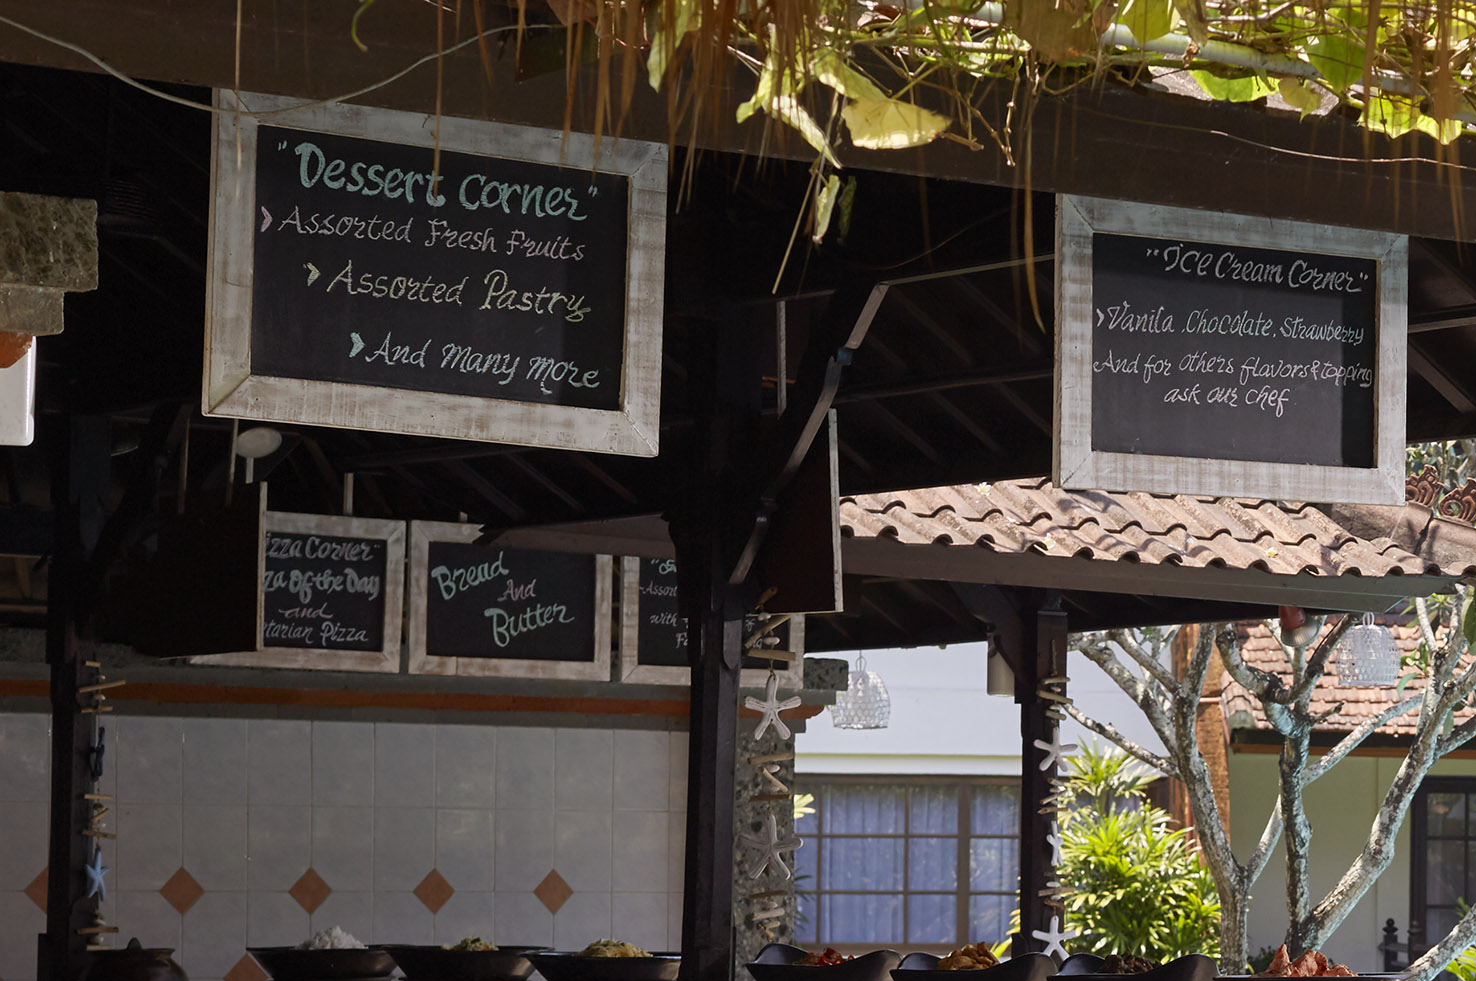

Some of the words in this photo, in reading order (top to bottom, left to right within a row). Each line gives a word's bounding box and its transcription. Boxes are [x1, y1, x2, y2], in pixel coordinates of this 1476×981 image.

[278, 140, 446, 207] "Dessert
[459, 174, 598, 221] Corner"
[277, 205, 416, 243] Assorted
[425, 218, 497, 253] Fresh
[506, 229, 586, 261] Fruits
[1214, 252, 1284, 285] Cream
[326, 259, 470, 306] Assorted
[479, 269, 592, 322] Pastry
[1107, 300, 1175, 334] Vanila
[1280, 316, 1364, 346] Strawberry
[365, 331, 432, 368] And
[1092, 349, 1141, 374] And
[1143, 354, 1172, 384] for
[1163, 383, 1200, 405] ask
[1206, 386, 1238, 407] our
[1245, 385, 1291, 418] chef
[265, 533, 303, 559] izza
[312, 568, 344, 594] the
[343, 567, 380, 601] Day
[431, 550, 510, 600] Bread
[497, 578, 537, 602] And
[320, 621, 369, 647] Pizza
[484, 603, 575, 648] Butter
[649, 612, 678, 628] with
